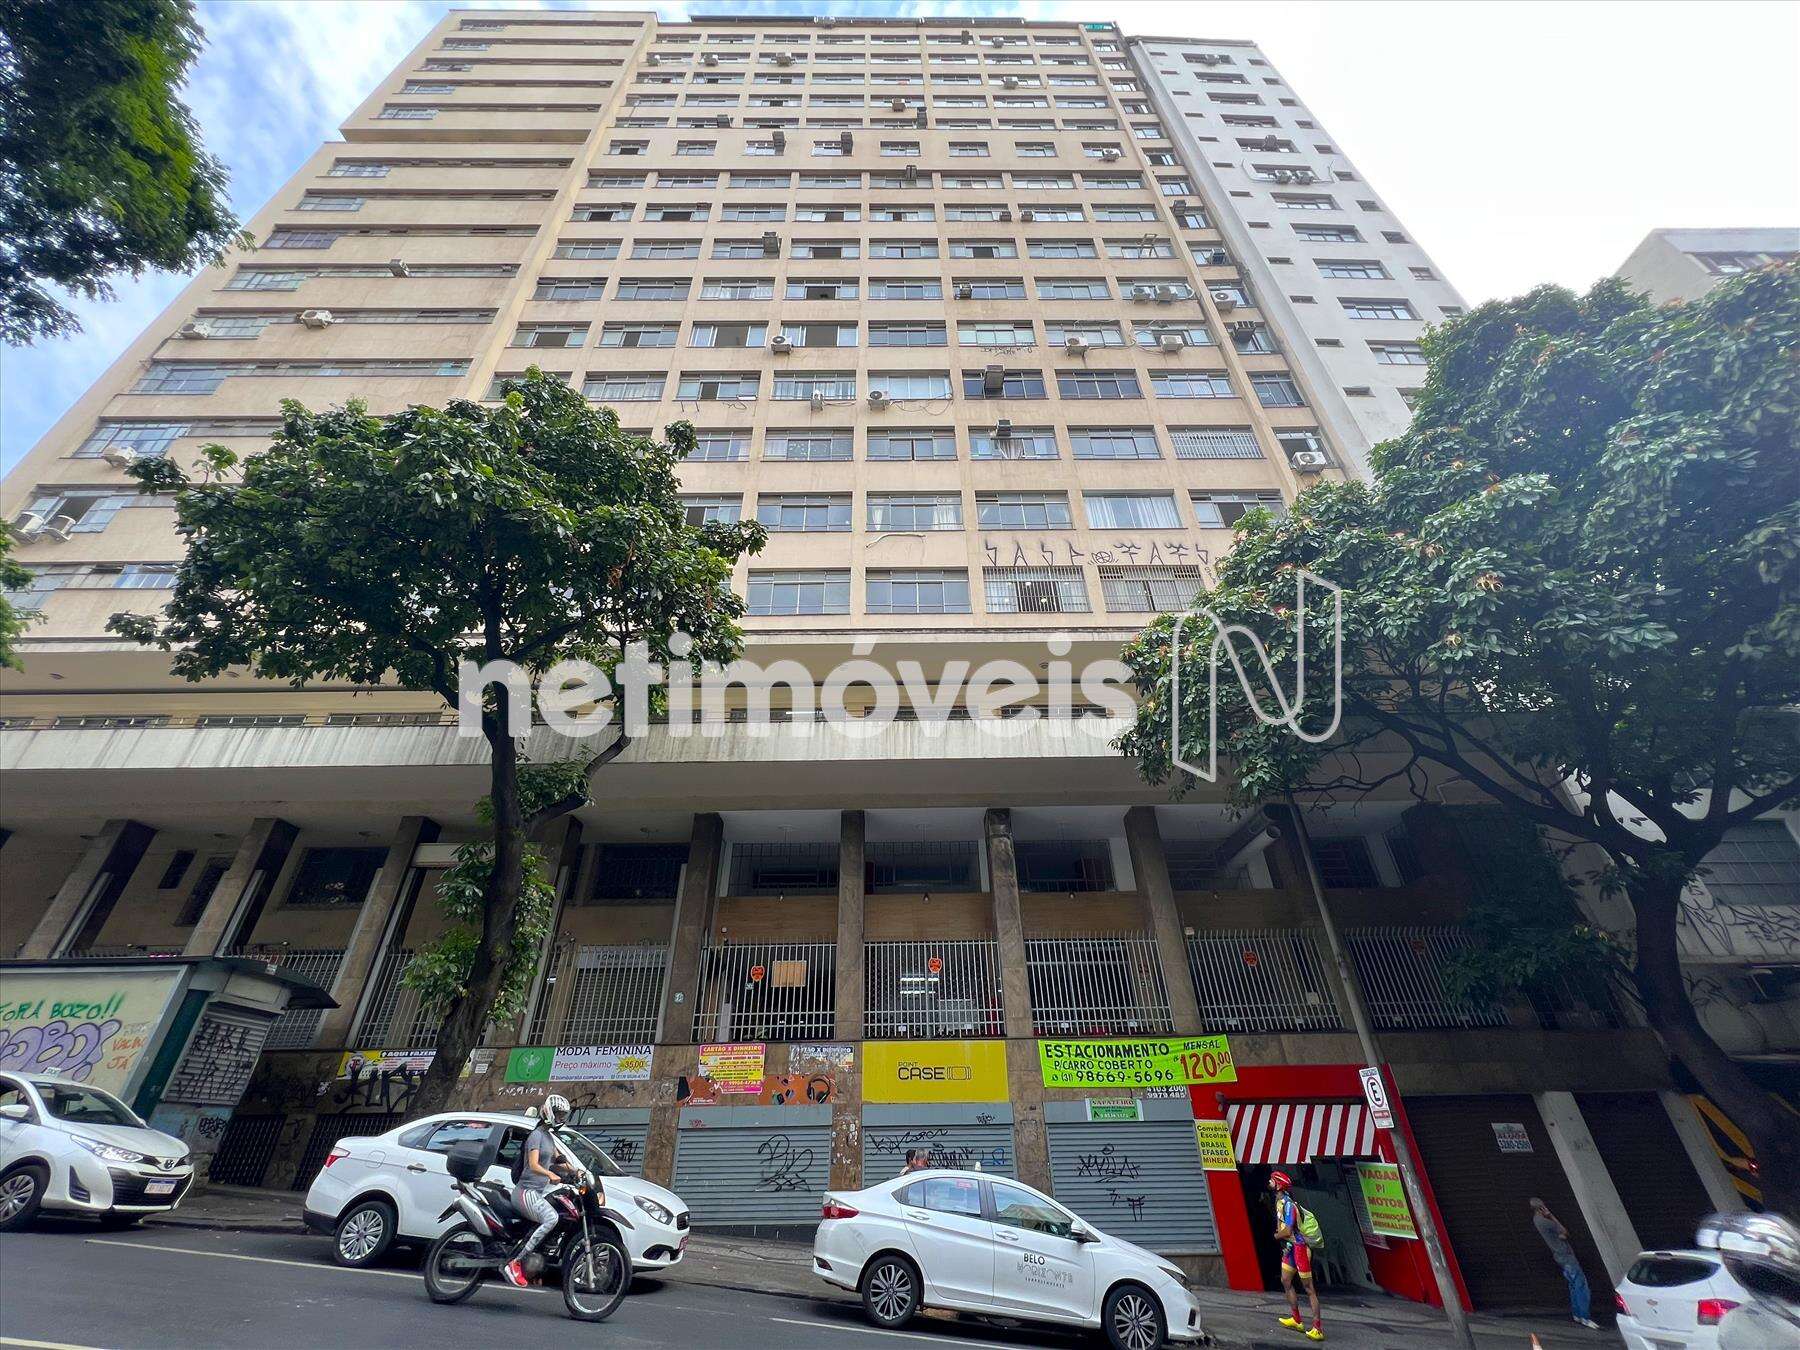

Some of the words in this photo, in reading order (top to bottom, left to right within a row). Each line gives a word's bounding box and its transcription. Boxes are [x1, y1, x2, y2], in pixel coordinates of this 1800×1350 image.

[556, 1046, 591, 1056] MODA
[595, 1045, 652, 1056] FEMININA
[1045, 1043, 1170, 1059] ESTACIONAMENTO
[1183, 1039, 1221, 1051] MENSAL
[554, 1061, 578, 1071] Preço
[1054, 1059, 1095, 1070] P/CARRO
[1098, 1059, 1153, 1070] COBERTO
[898, 1067, 946, 1081] CASE
[1076, 1070, 1174, 1083] 98669-5696
[1369, 1081, 1381, 1102] E
[1360, 1169, 1399, 1180] VAGAS
[1023, 1253, 1046, 1265] BELO
